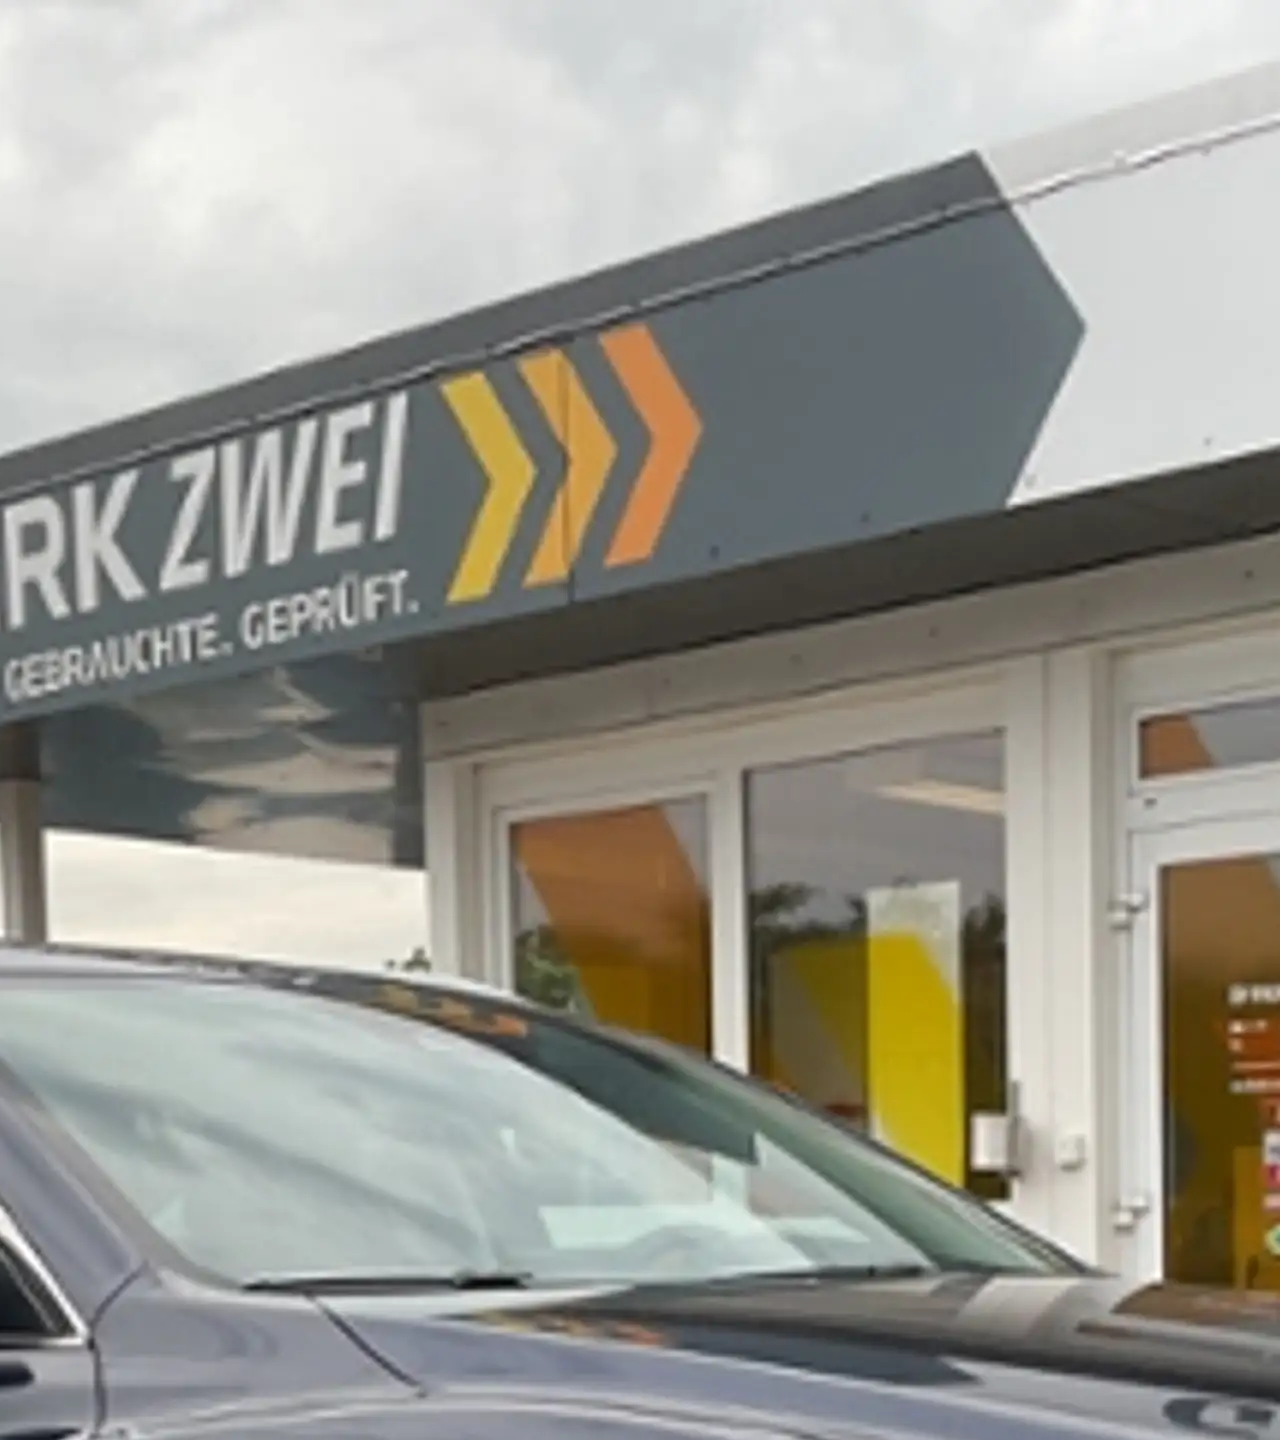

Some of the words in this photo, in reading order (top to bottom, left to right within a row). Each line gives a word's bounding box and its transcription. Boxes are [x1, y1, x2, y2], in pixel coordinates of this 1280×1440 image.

[158, 393, 407, 592] ZWEI
[4, 612, 233, 702] GEBRAUCHTE.
[241, 568, 420, 650] GEPRÜFT.
